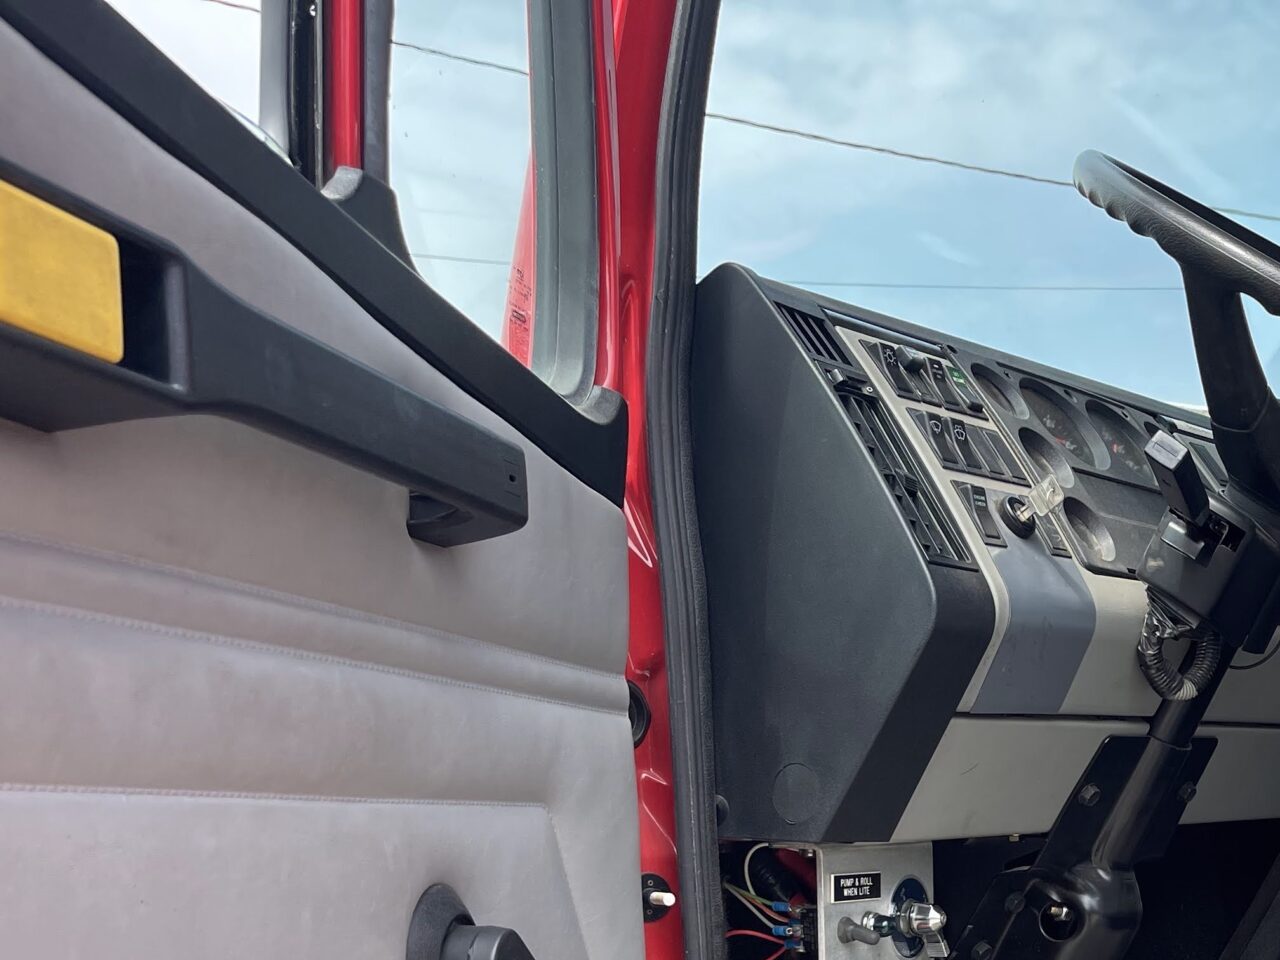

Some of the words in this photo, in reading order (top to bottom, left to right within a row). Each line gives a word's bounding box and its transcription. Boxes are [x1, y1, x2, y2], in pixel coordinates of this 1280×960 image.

[841, 879, 854, 887] PUMP
[860, 877, 873, 885] ROLL
[843, 887, 858, 896] WHEN
[859, 887, 870, 895] LITE
